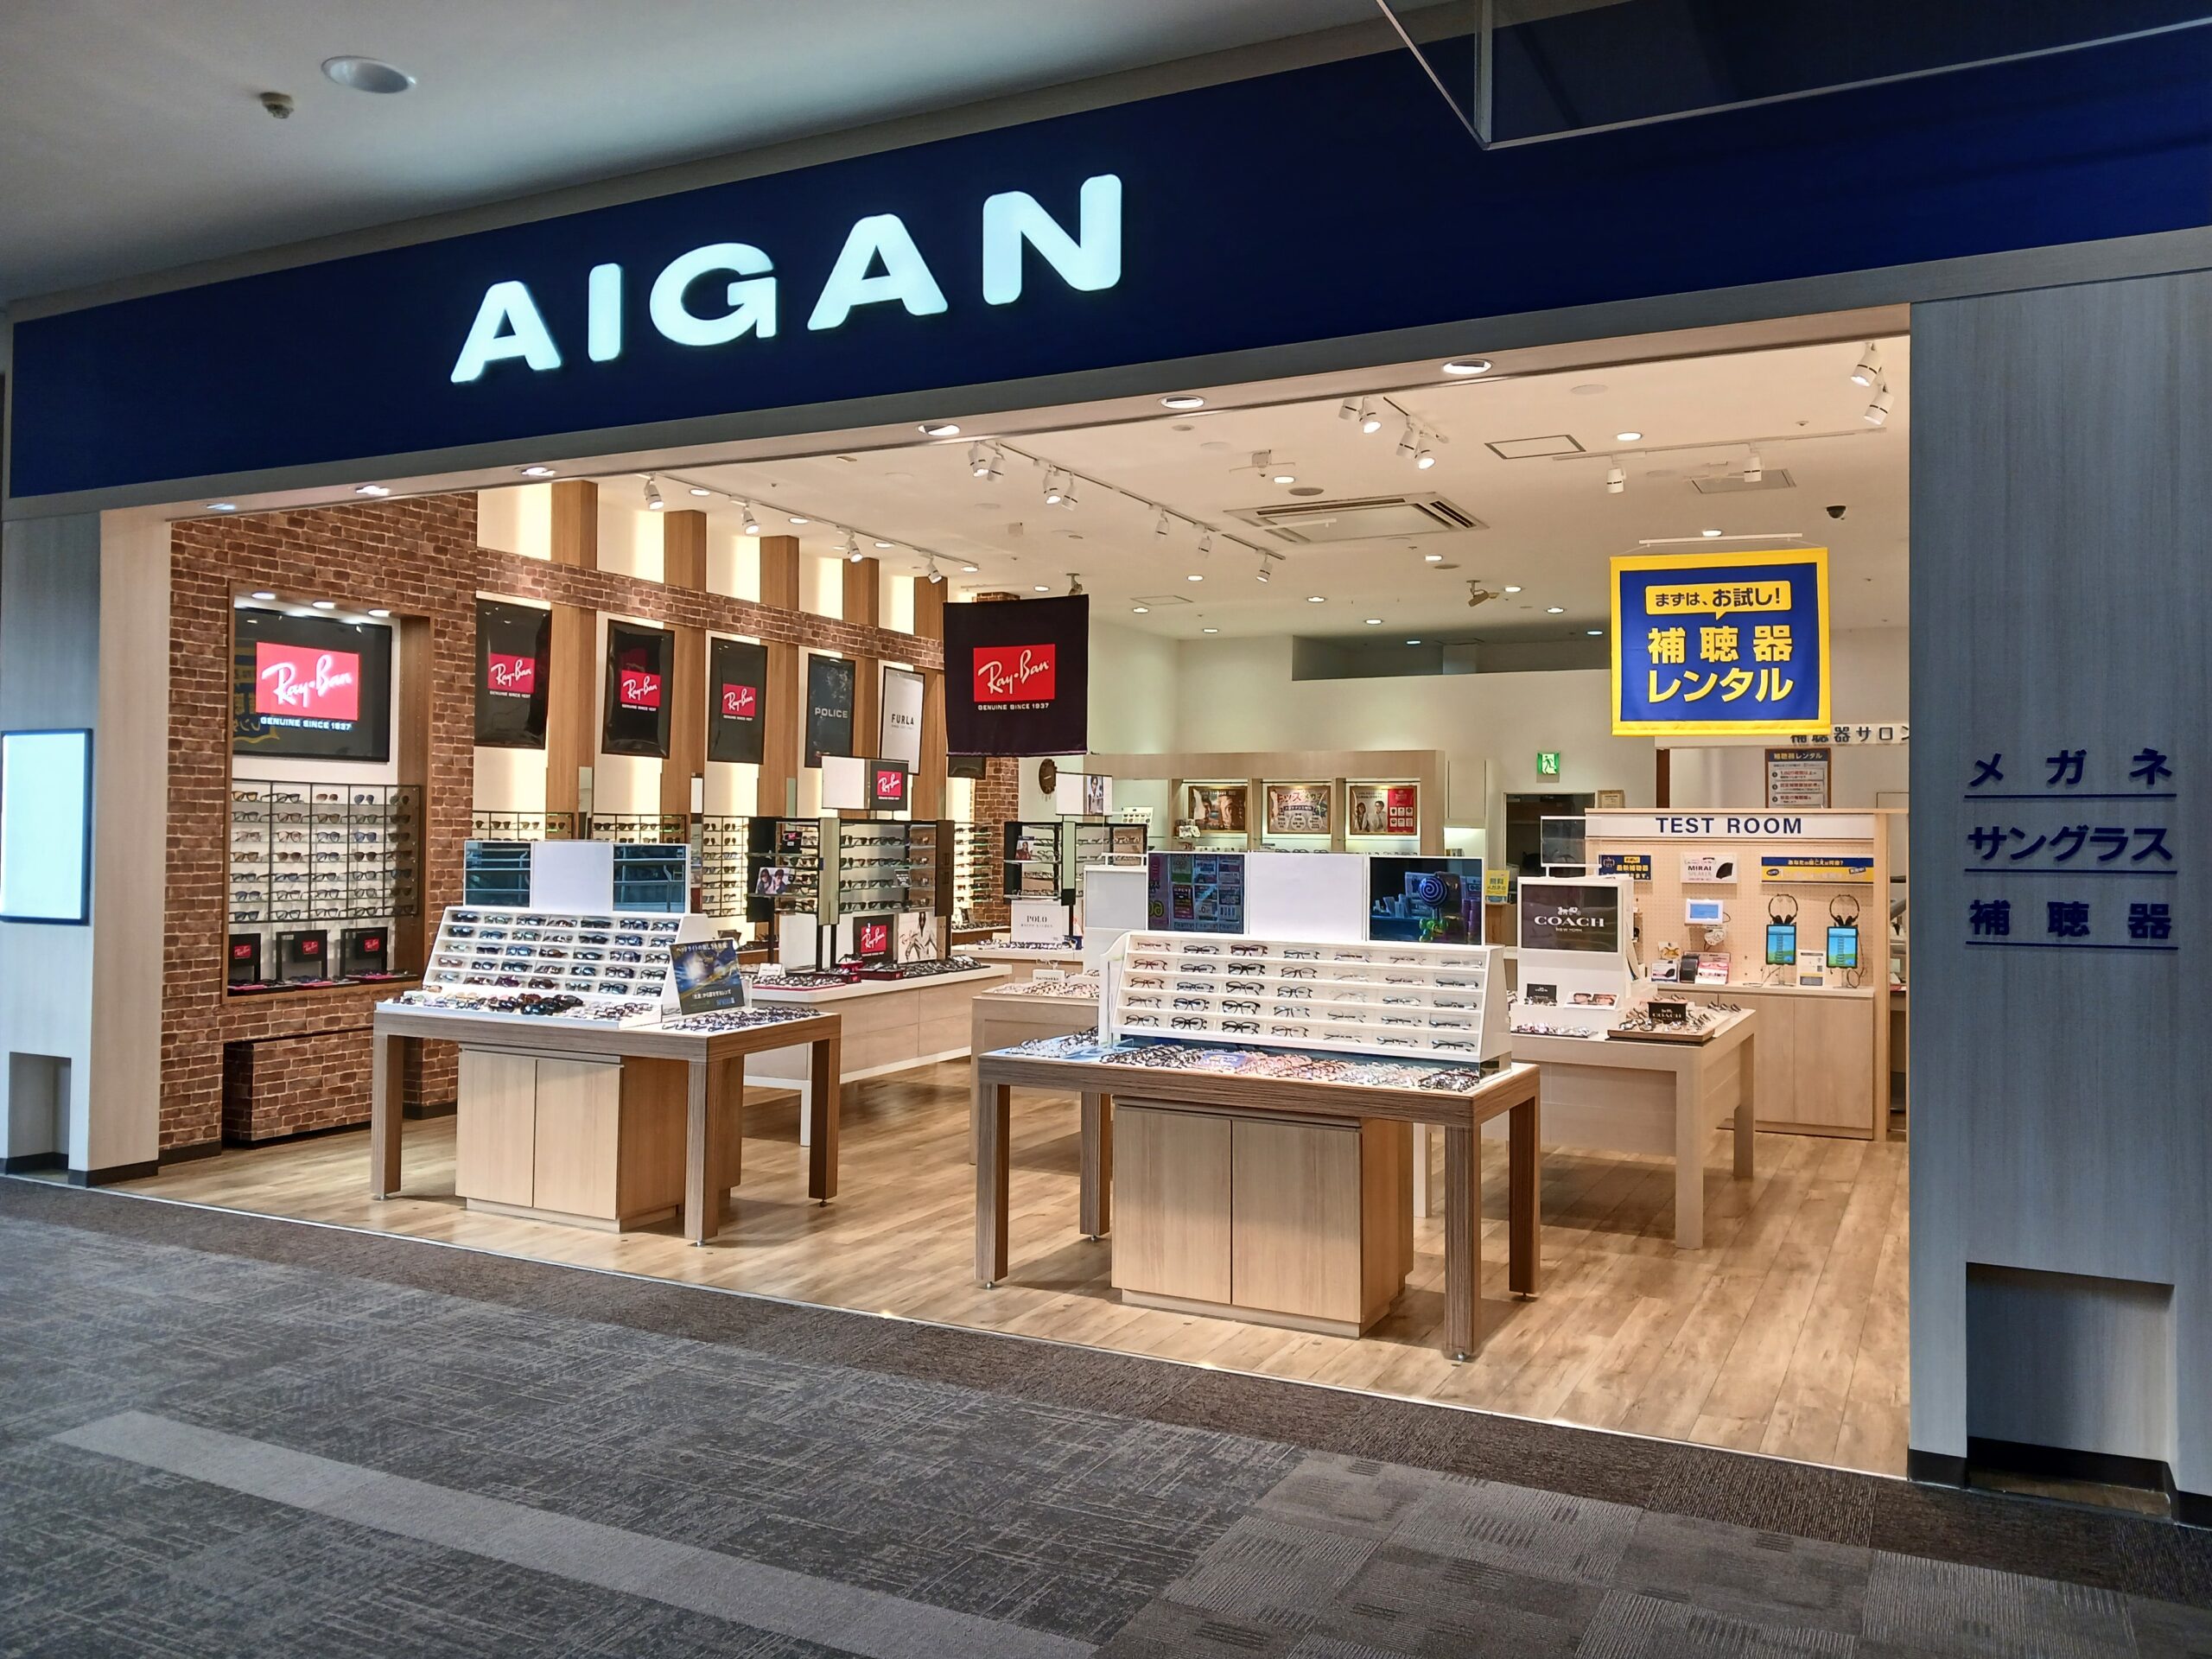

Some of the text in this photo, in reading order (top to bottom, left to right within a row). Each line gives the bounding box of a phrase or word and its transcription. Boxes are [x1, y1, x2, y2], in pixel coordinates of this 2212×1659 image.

[450, 174, 1122, 384] AIGAN
[1655, 588, 1781, 607] まずは、お試し!
[1648, 625, 1793, 664] 補聴器
[1649, 667, 1794, 703] レンタル
[260, 716, 301, 728] GENUINE
[303, 719, 330, 729] SINCE
[815, 707, 849, 718] POLICE
[891, 714, 914, 725] FURLA
[1969, 747, 2172, 786] メガネ
[1656, 817, 1802, 835] TEST ROOM
[1967, 824, 2173, 861] サングラス
[1534, 916, 1604, 927] COACH
[1969, 899, 2171, 939] 補聴器
